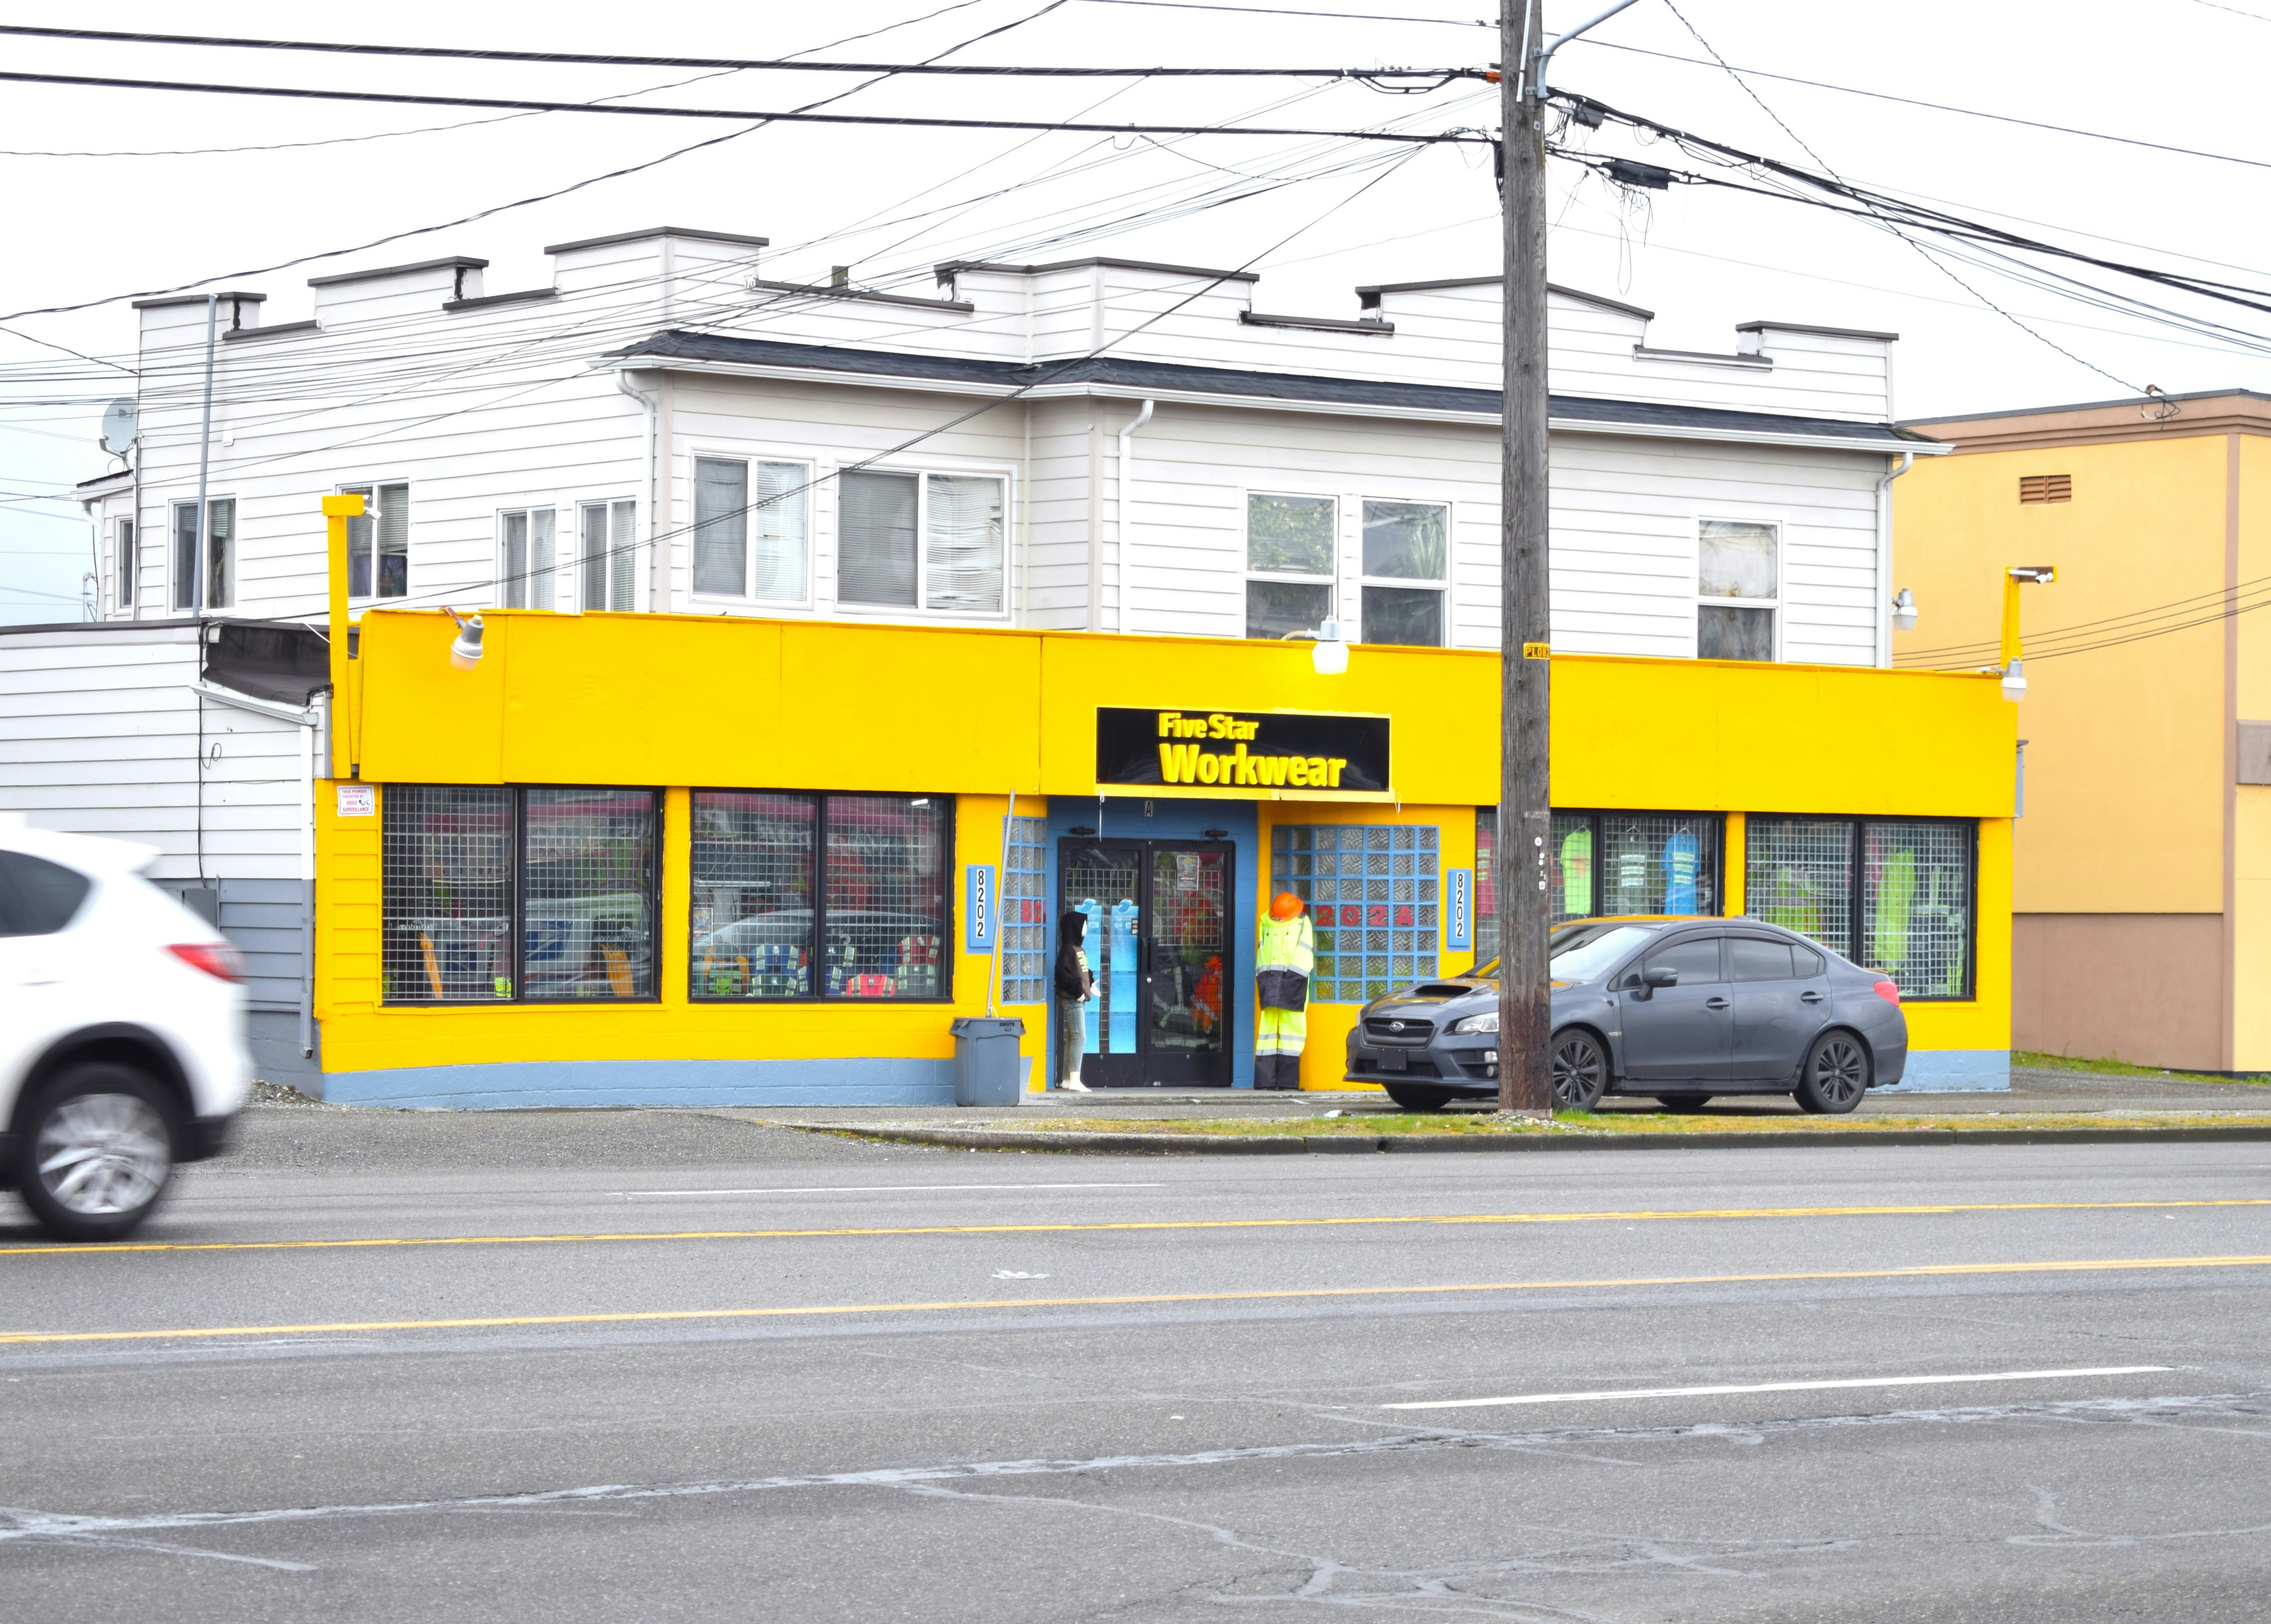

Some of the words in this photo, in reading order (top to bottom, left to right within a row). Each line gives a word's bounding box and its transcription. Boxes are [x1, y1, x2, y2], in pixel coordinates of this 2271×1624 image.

[1158, 713, 1207, 738] Five
[1208, 714, 1259, 740] Star
[1159, 743, 1346, 787] Workwear
[1145, 801, 1152, 816] A
[1021, 900, 1046, 923] 82
[1303, 905, 1414, 927] 202A
